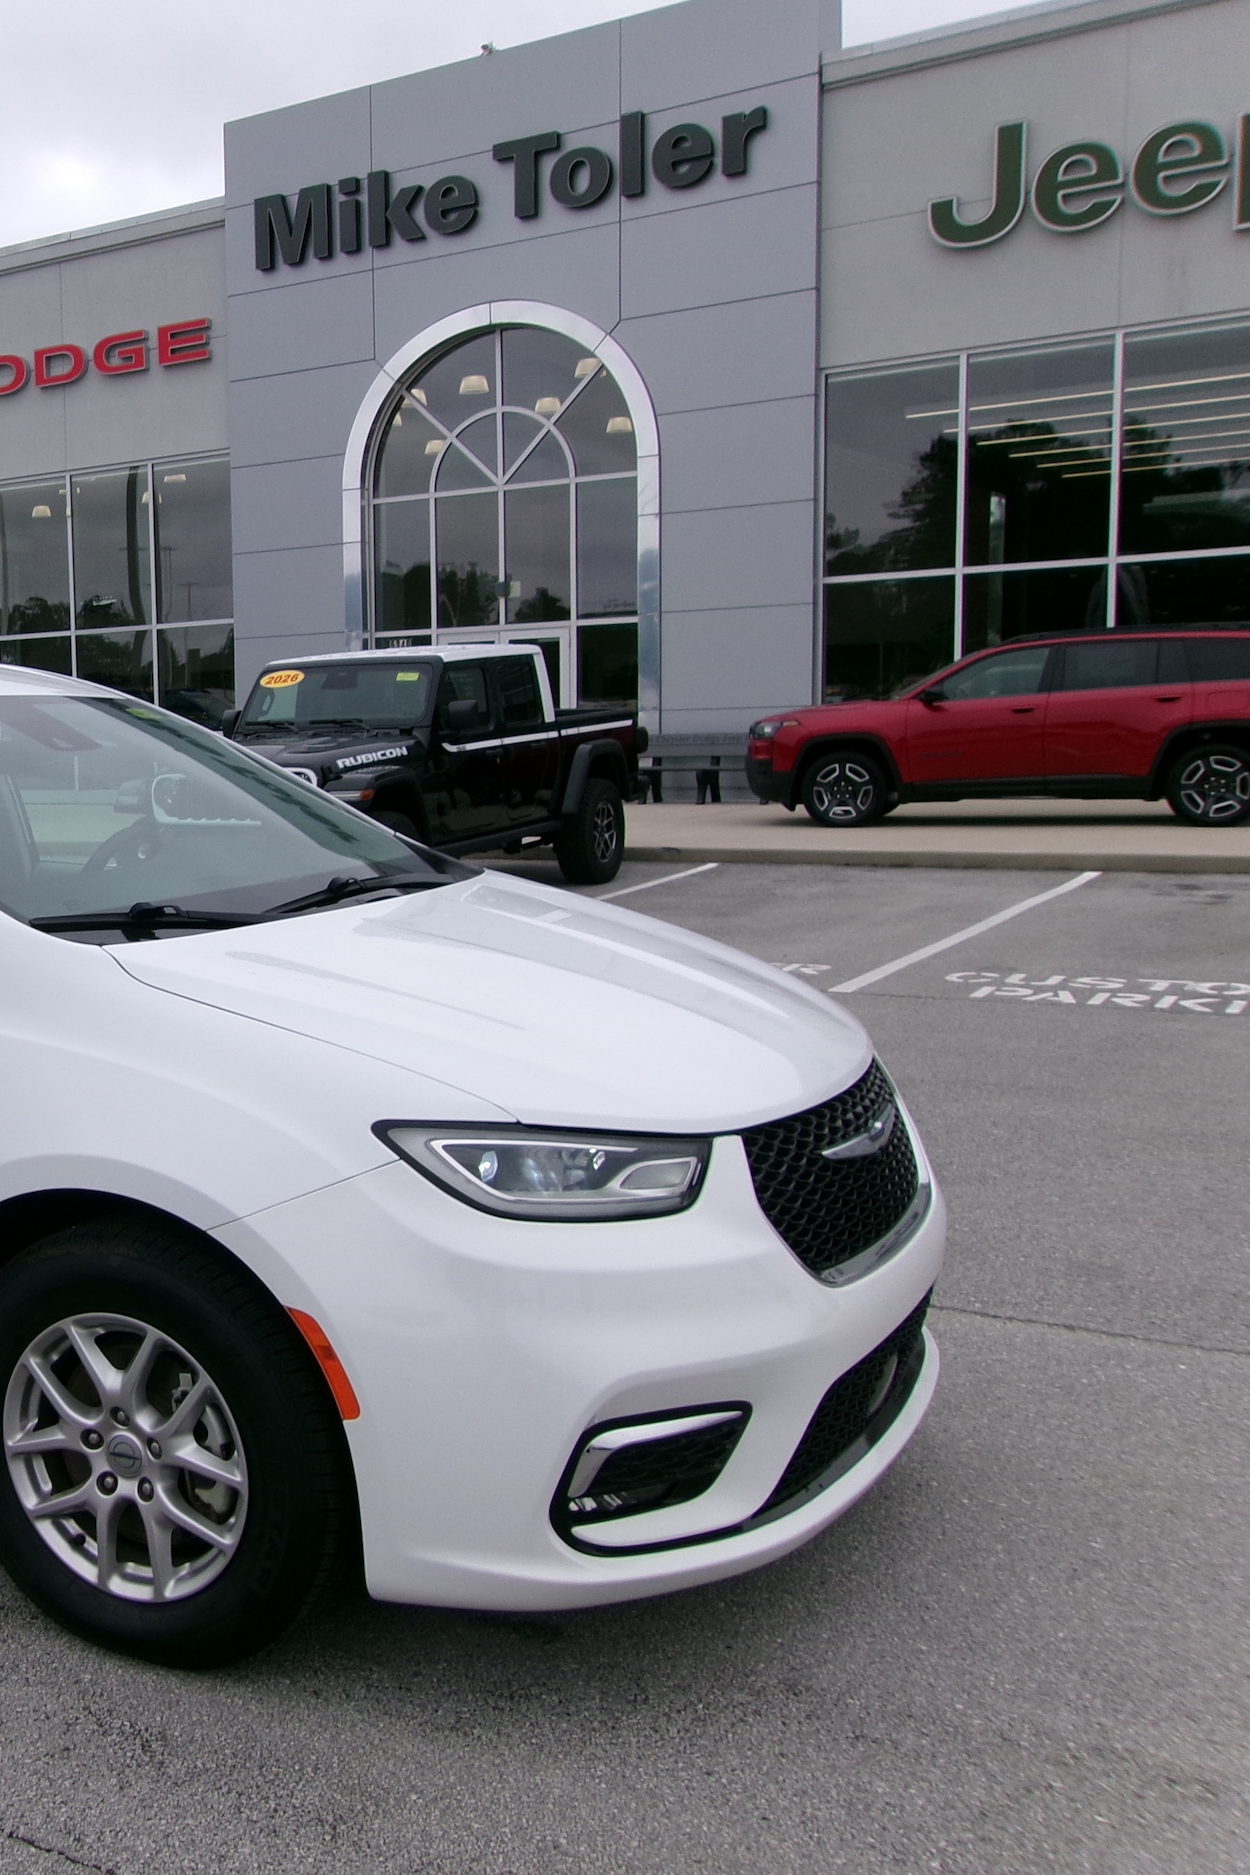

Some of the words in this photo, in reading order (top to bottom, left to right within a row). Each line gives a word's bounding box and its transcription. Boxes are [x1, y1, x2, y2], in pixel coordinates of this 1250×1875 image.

[253, 169, 479, 271] Mike
[492, 105, 768, 219] Toler
[927, 113, 1250, 250] Jee
[264, 673, 300, 685] 2026
[336, 746, 409, 769] RUBICON
